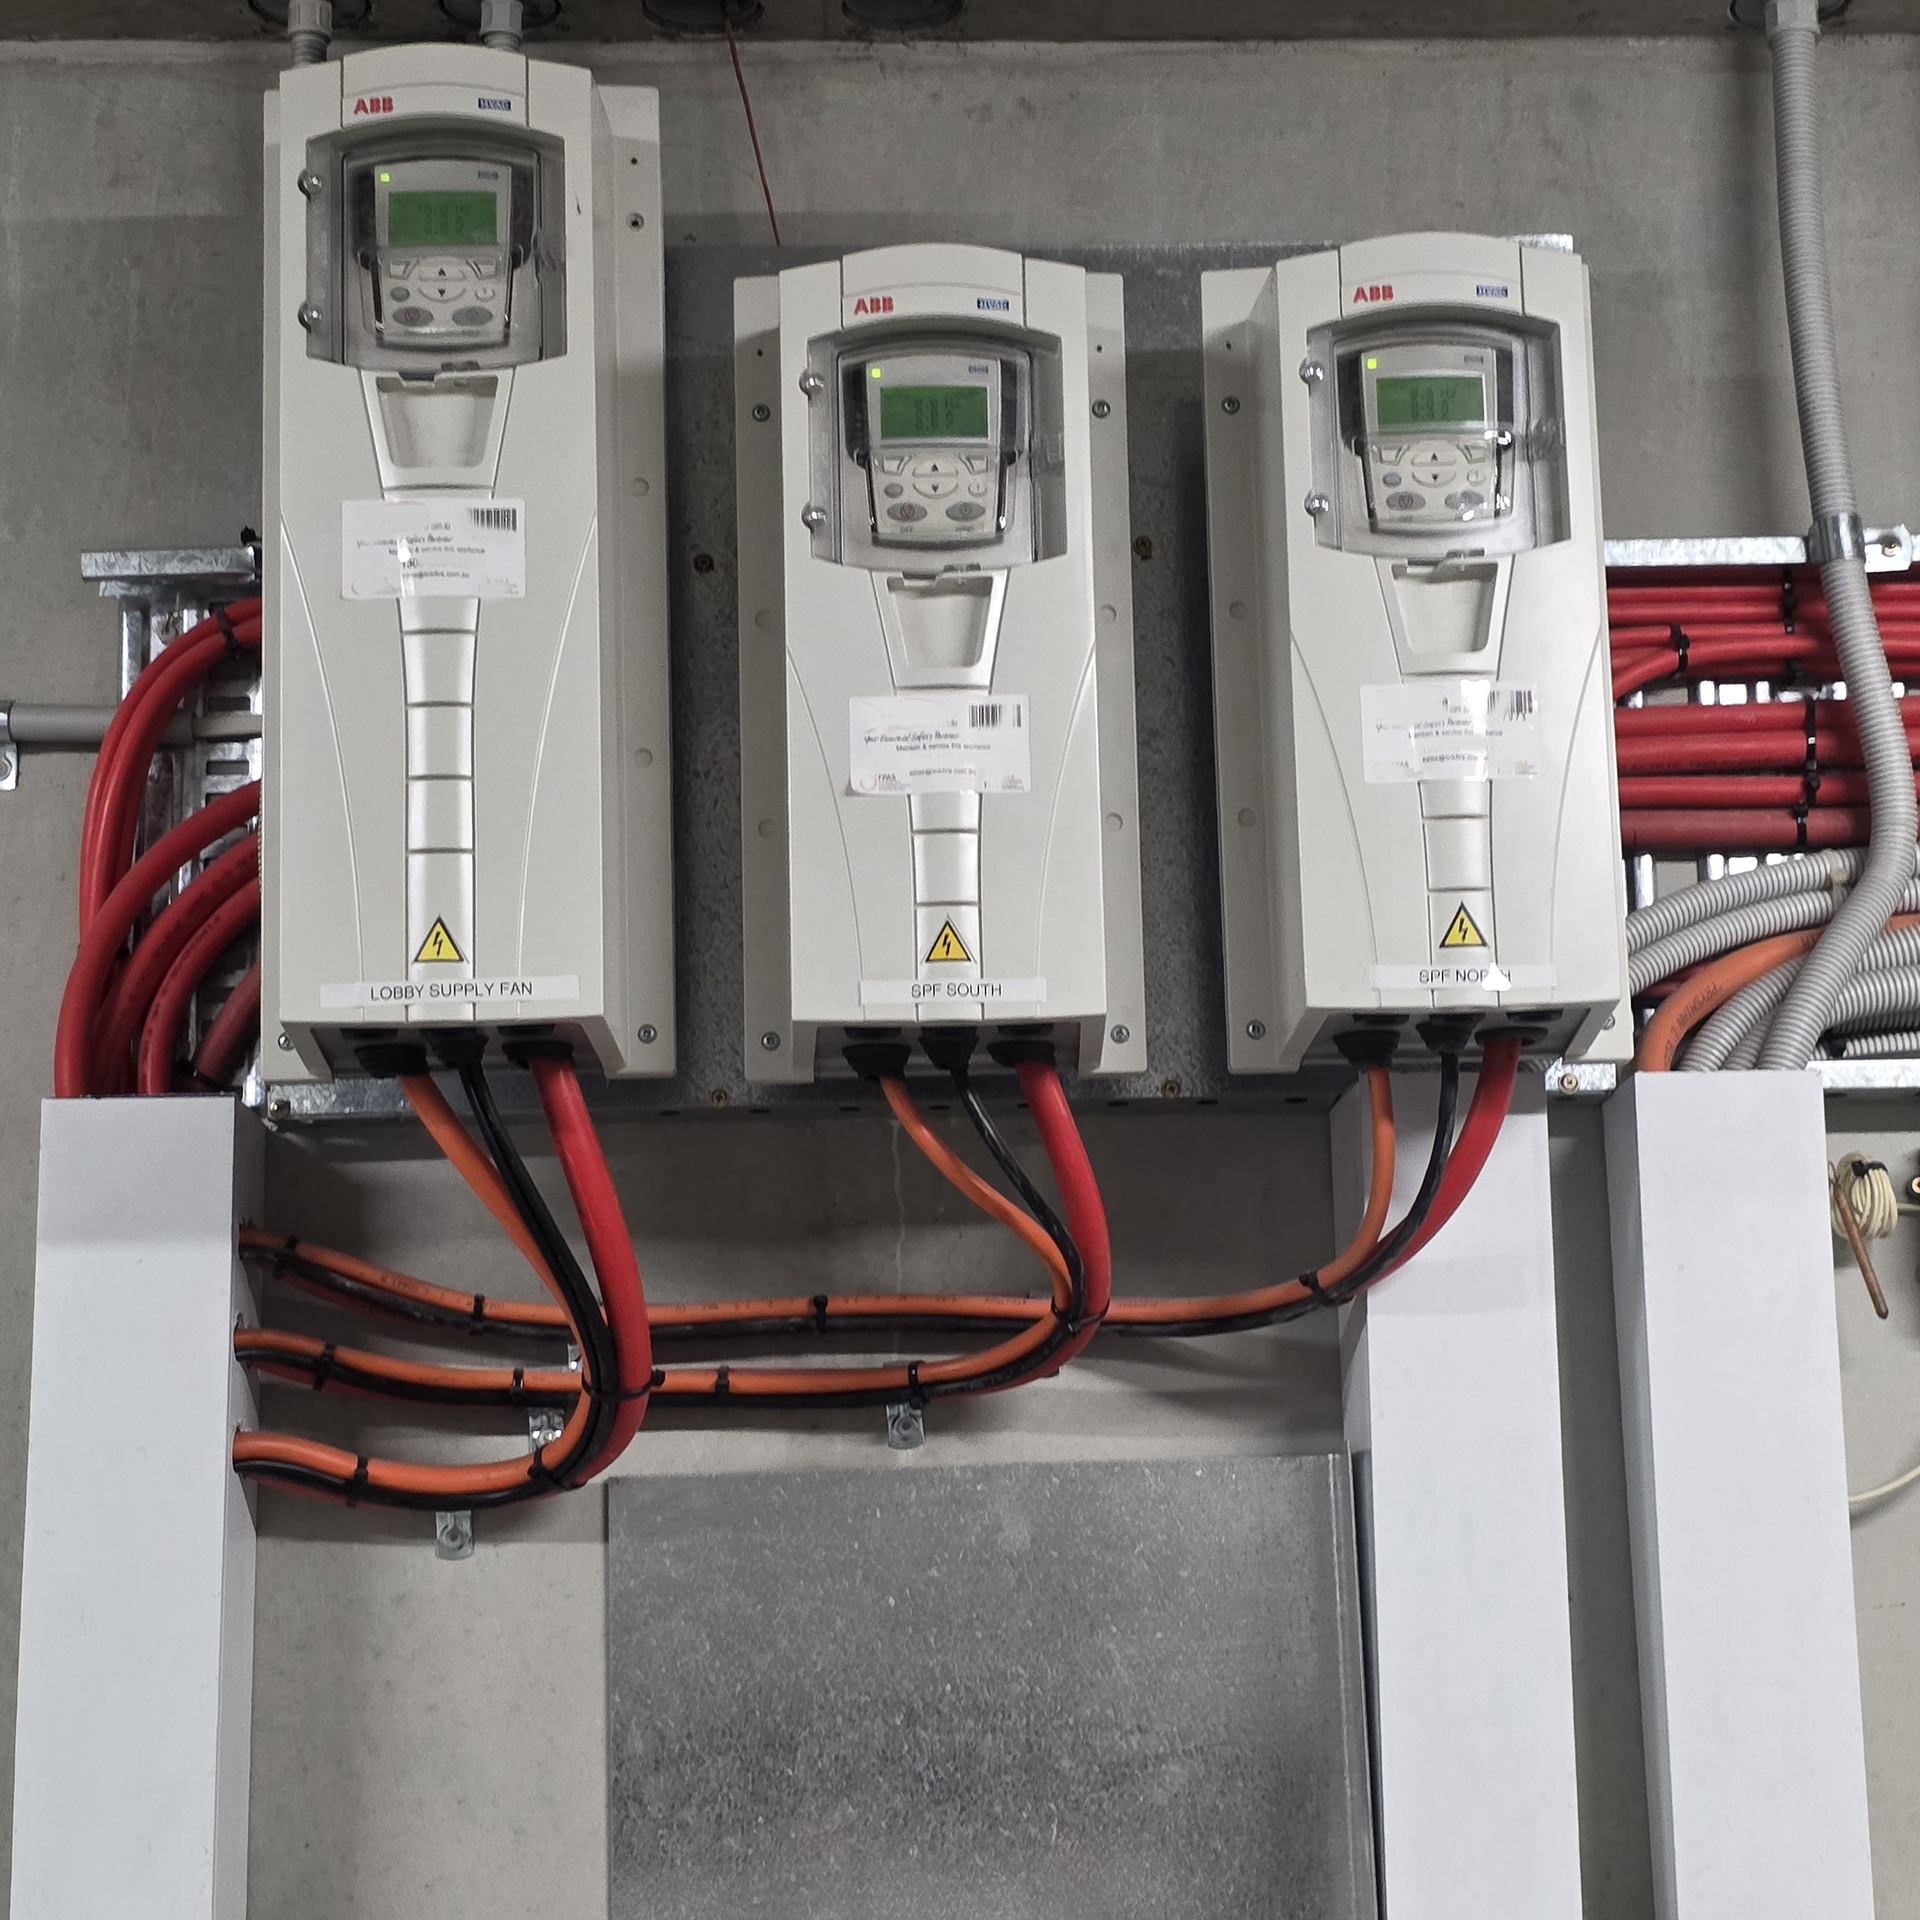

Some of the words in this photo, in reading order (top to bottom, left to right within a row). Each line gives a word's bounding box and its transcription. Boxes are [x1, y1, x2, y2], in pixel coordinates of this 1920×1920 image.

[354, 96, 394, 115] ABB
[1353, 284, 1394, 304] ABB
[854, 295, 894, 315] ABB
[1419, 968, 1450, 984] SPF
[1455, 968, 1511, 984] NOR
[370, 984, 424, 1001] LOBBY
[429, 982, 494, 998] SUPPLY
[500, 981, 533, 996] FAN
[911, 983, 942, 998] SPF
[947, 982, 1002, 998] SOUTH
